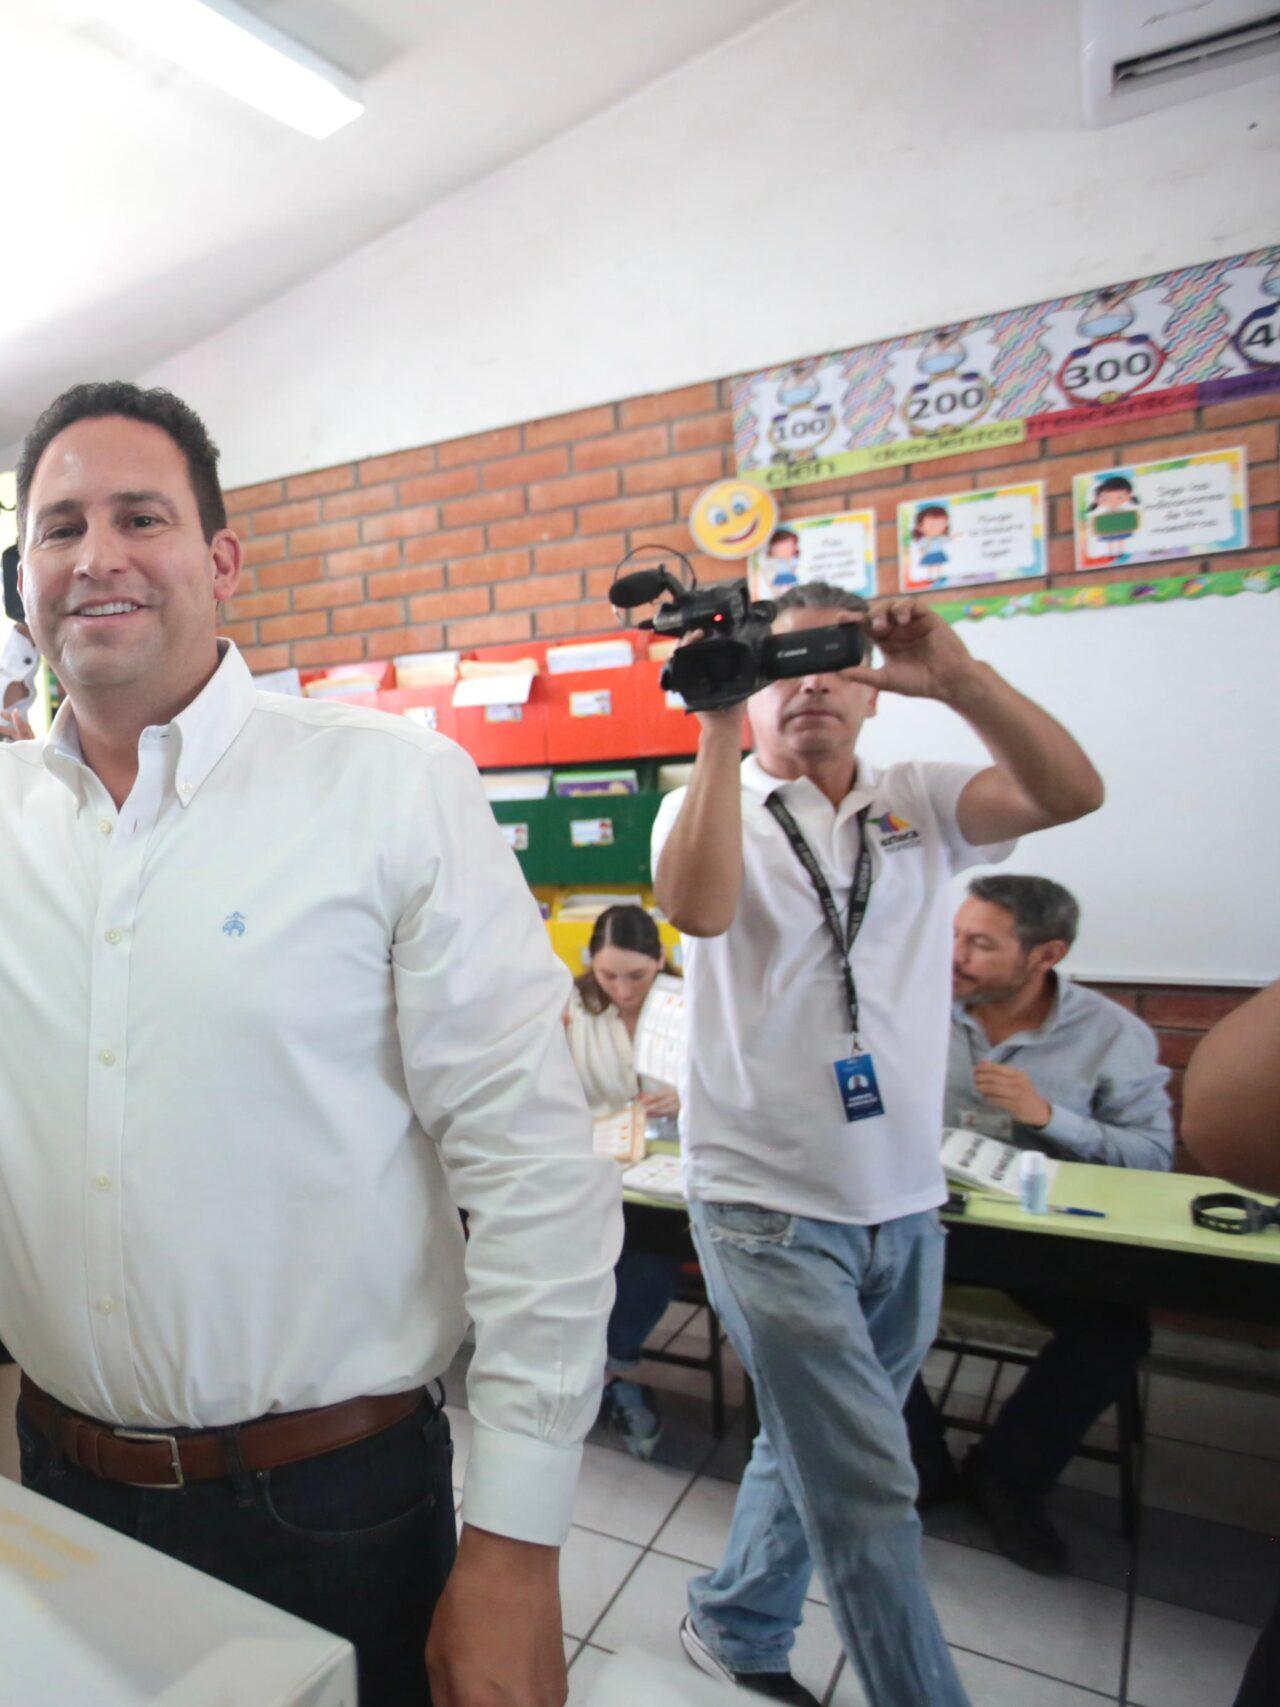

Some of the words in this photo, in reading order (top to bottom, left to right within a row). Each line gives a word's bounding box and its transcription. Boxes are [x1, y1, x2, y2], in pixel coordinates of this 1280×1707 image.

[1065, 352, 1152, 391] 300
[909, 386, 984, 420] 200
[776, 417, 827, 441] 100
[874, 424, 1019, 463] doscientos
[766, 459, 835, 484] cien
